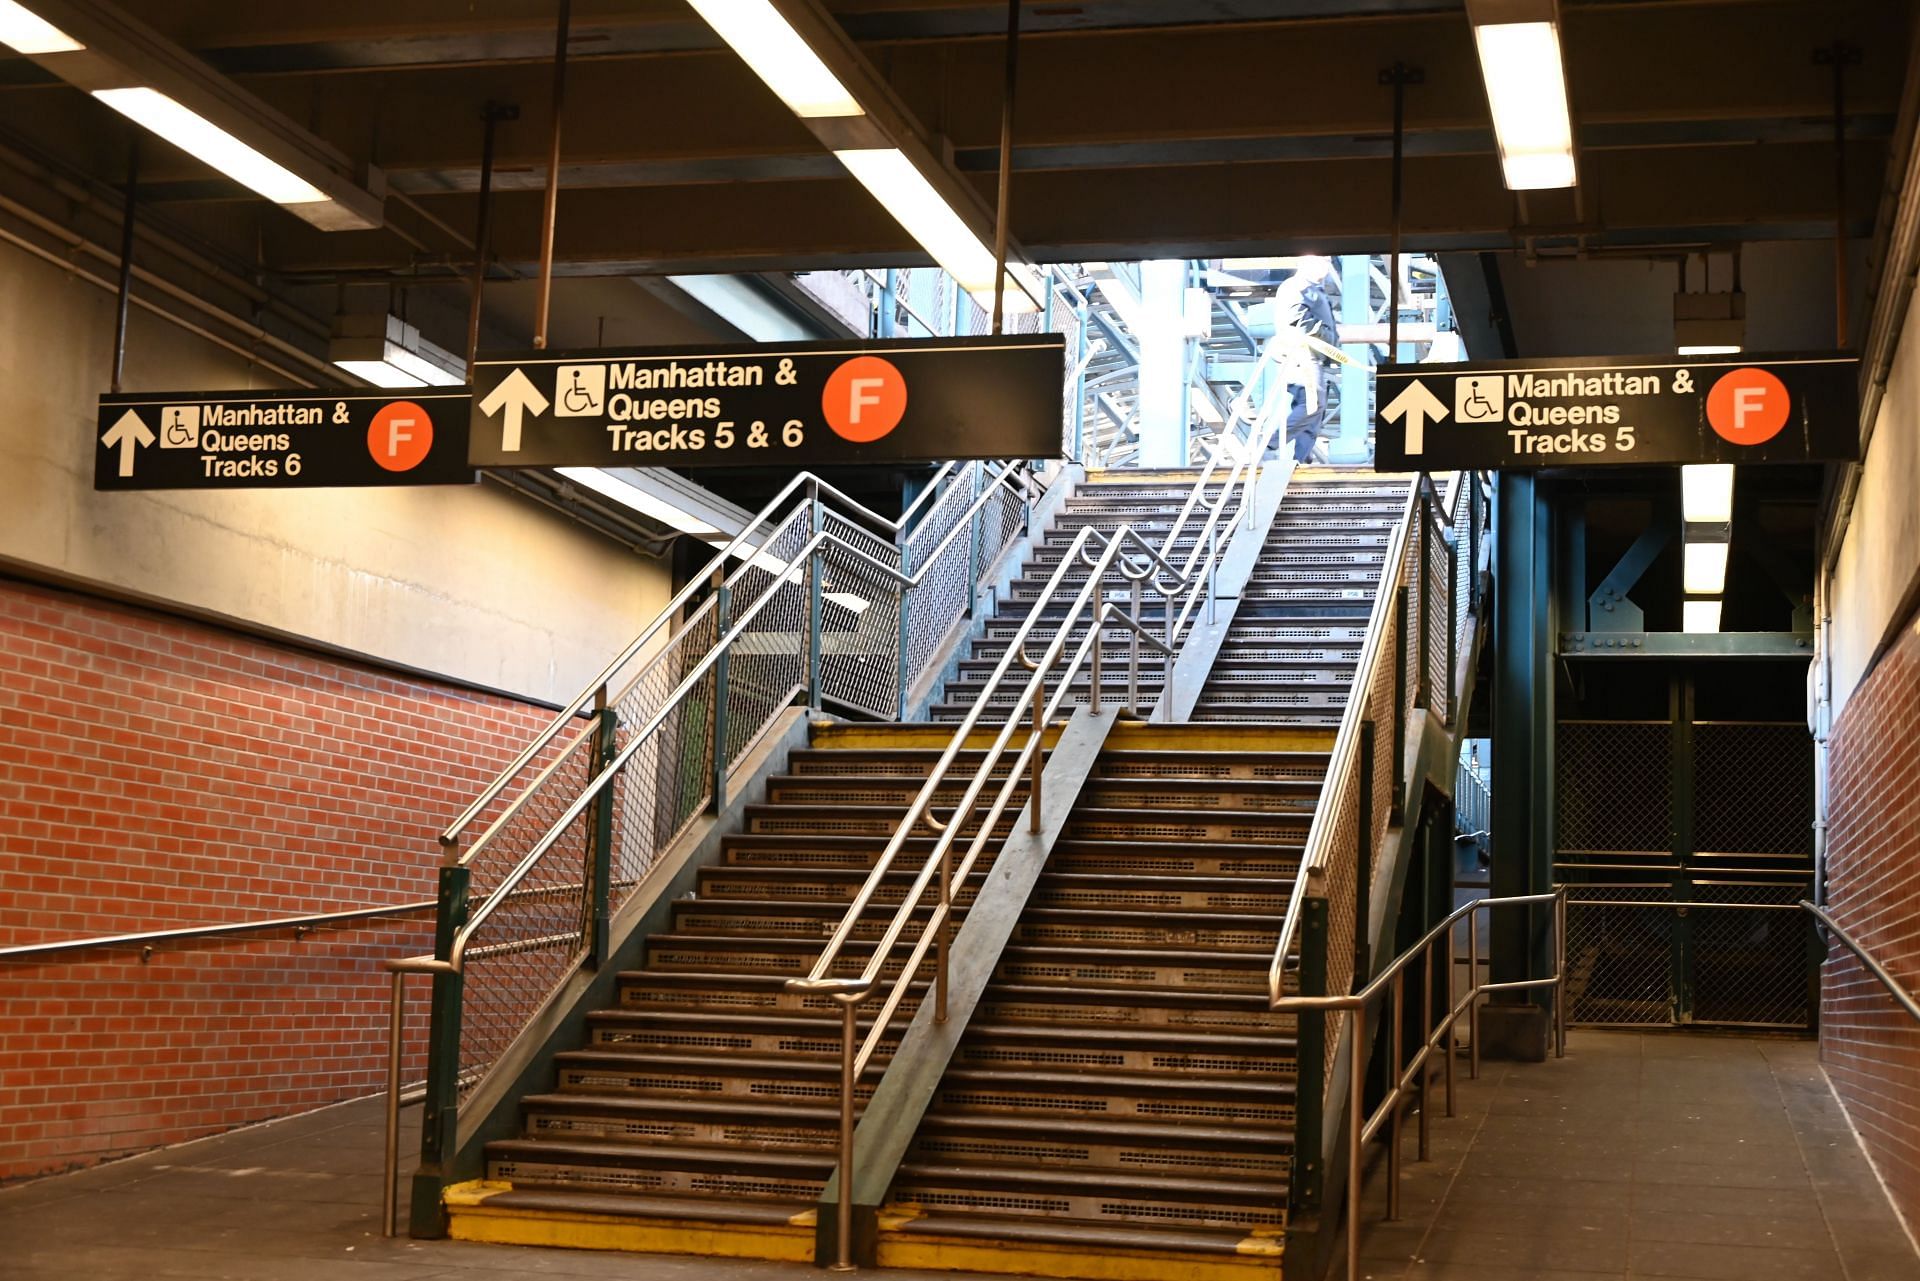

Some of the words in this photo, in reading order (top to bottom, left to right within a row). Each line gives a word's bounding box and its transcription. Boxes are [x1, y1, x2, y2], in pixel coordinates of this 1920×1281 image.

[608, 362, 763, 391] Manhattan
[774, 358, 797, 386] &
[1507, 371, 1661, 400] Manhattan
[1671, 368, 1695, 394] &
[202, 403, 323, 427] Manhattan
[331, 401, 350, 425] &
[607, 393, 721, 422] Queens
[849, 377, 885, 424] F
[1507, 401, 1621, 428] Queens
[1733, 387, 1767, 429] F
[201, 429, 290, 453] Queens
[388, 418, 416, 457] F
[606, 423, 706, 453] Tracks
[713, 421, 735, 449] 5
[746, 420, 769, 449] &
[782, 419, 804, 448] 6
[1507, 428, 1607, 455] Tracks
[1614, 426, 1636, 452] 5
[200, 454, 278, 478] Tracks
[284, 453, 301, 476] 6
